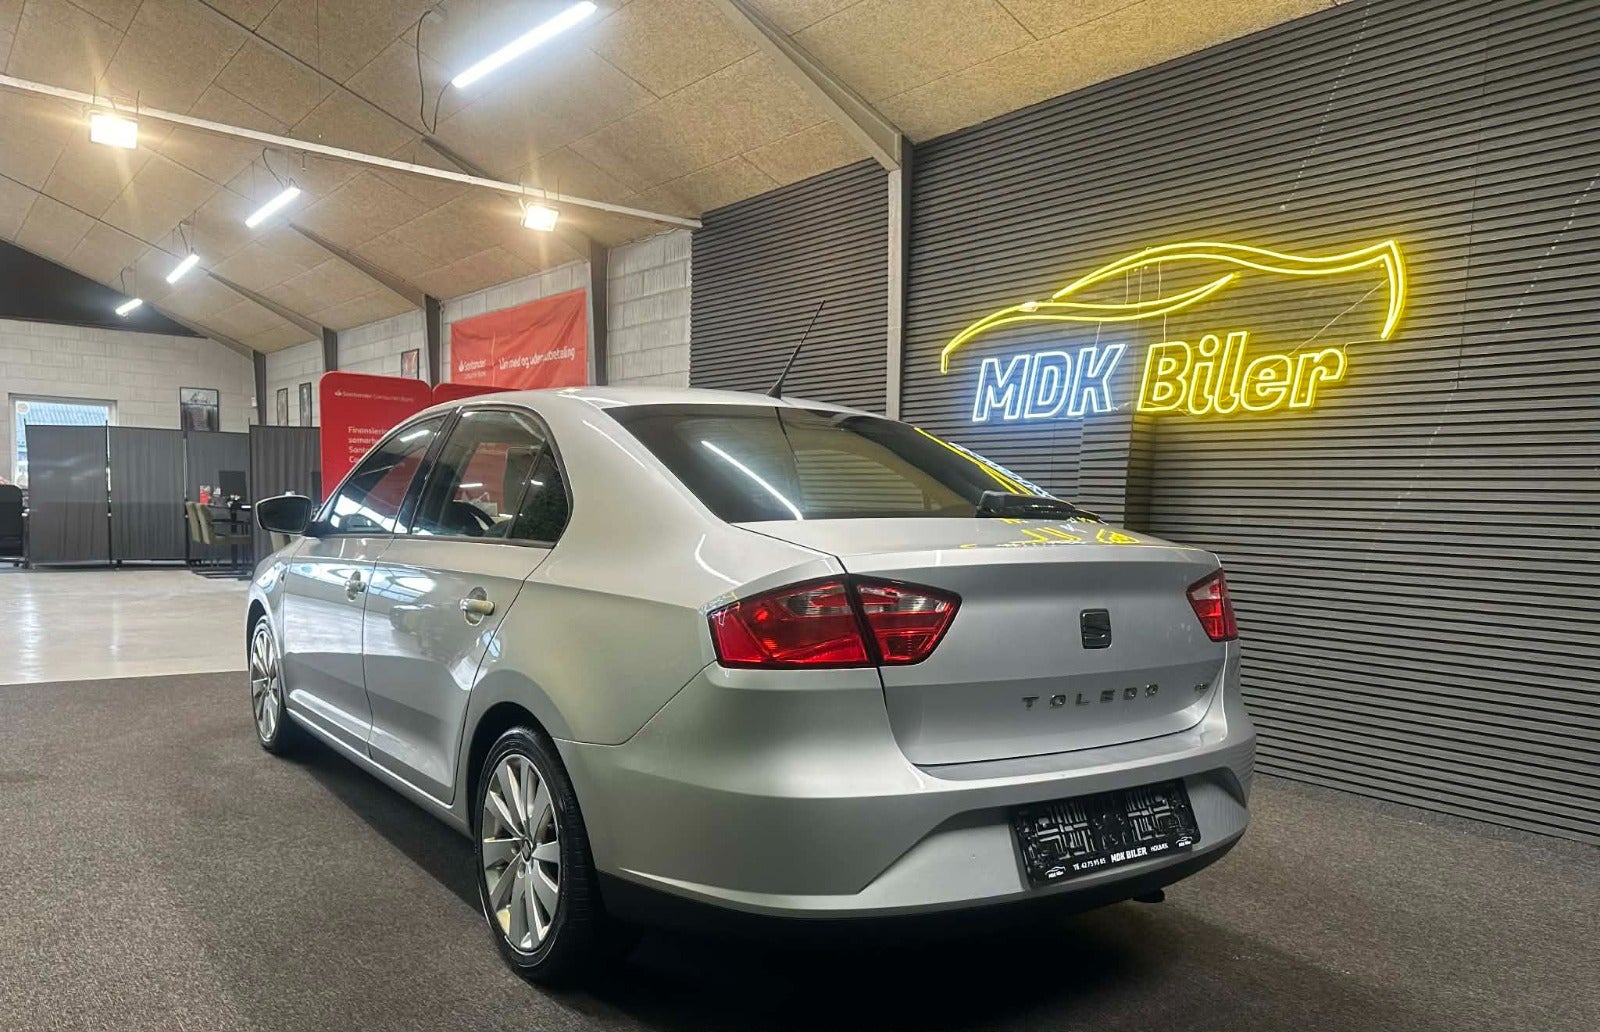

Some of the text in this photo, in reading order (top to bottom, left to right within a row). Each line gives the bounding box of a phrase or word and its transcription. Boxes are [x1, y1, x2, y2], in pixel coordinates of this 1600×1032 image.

[521, 356, 530, 369] og
[972, 330, 1347, 422] MDK Biler
[1022, 683, 1159, 711] TOLEDO
[1110, 851, 1126, 863] MDK
[1125, 846, 1148, 860] BILER
